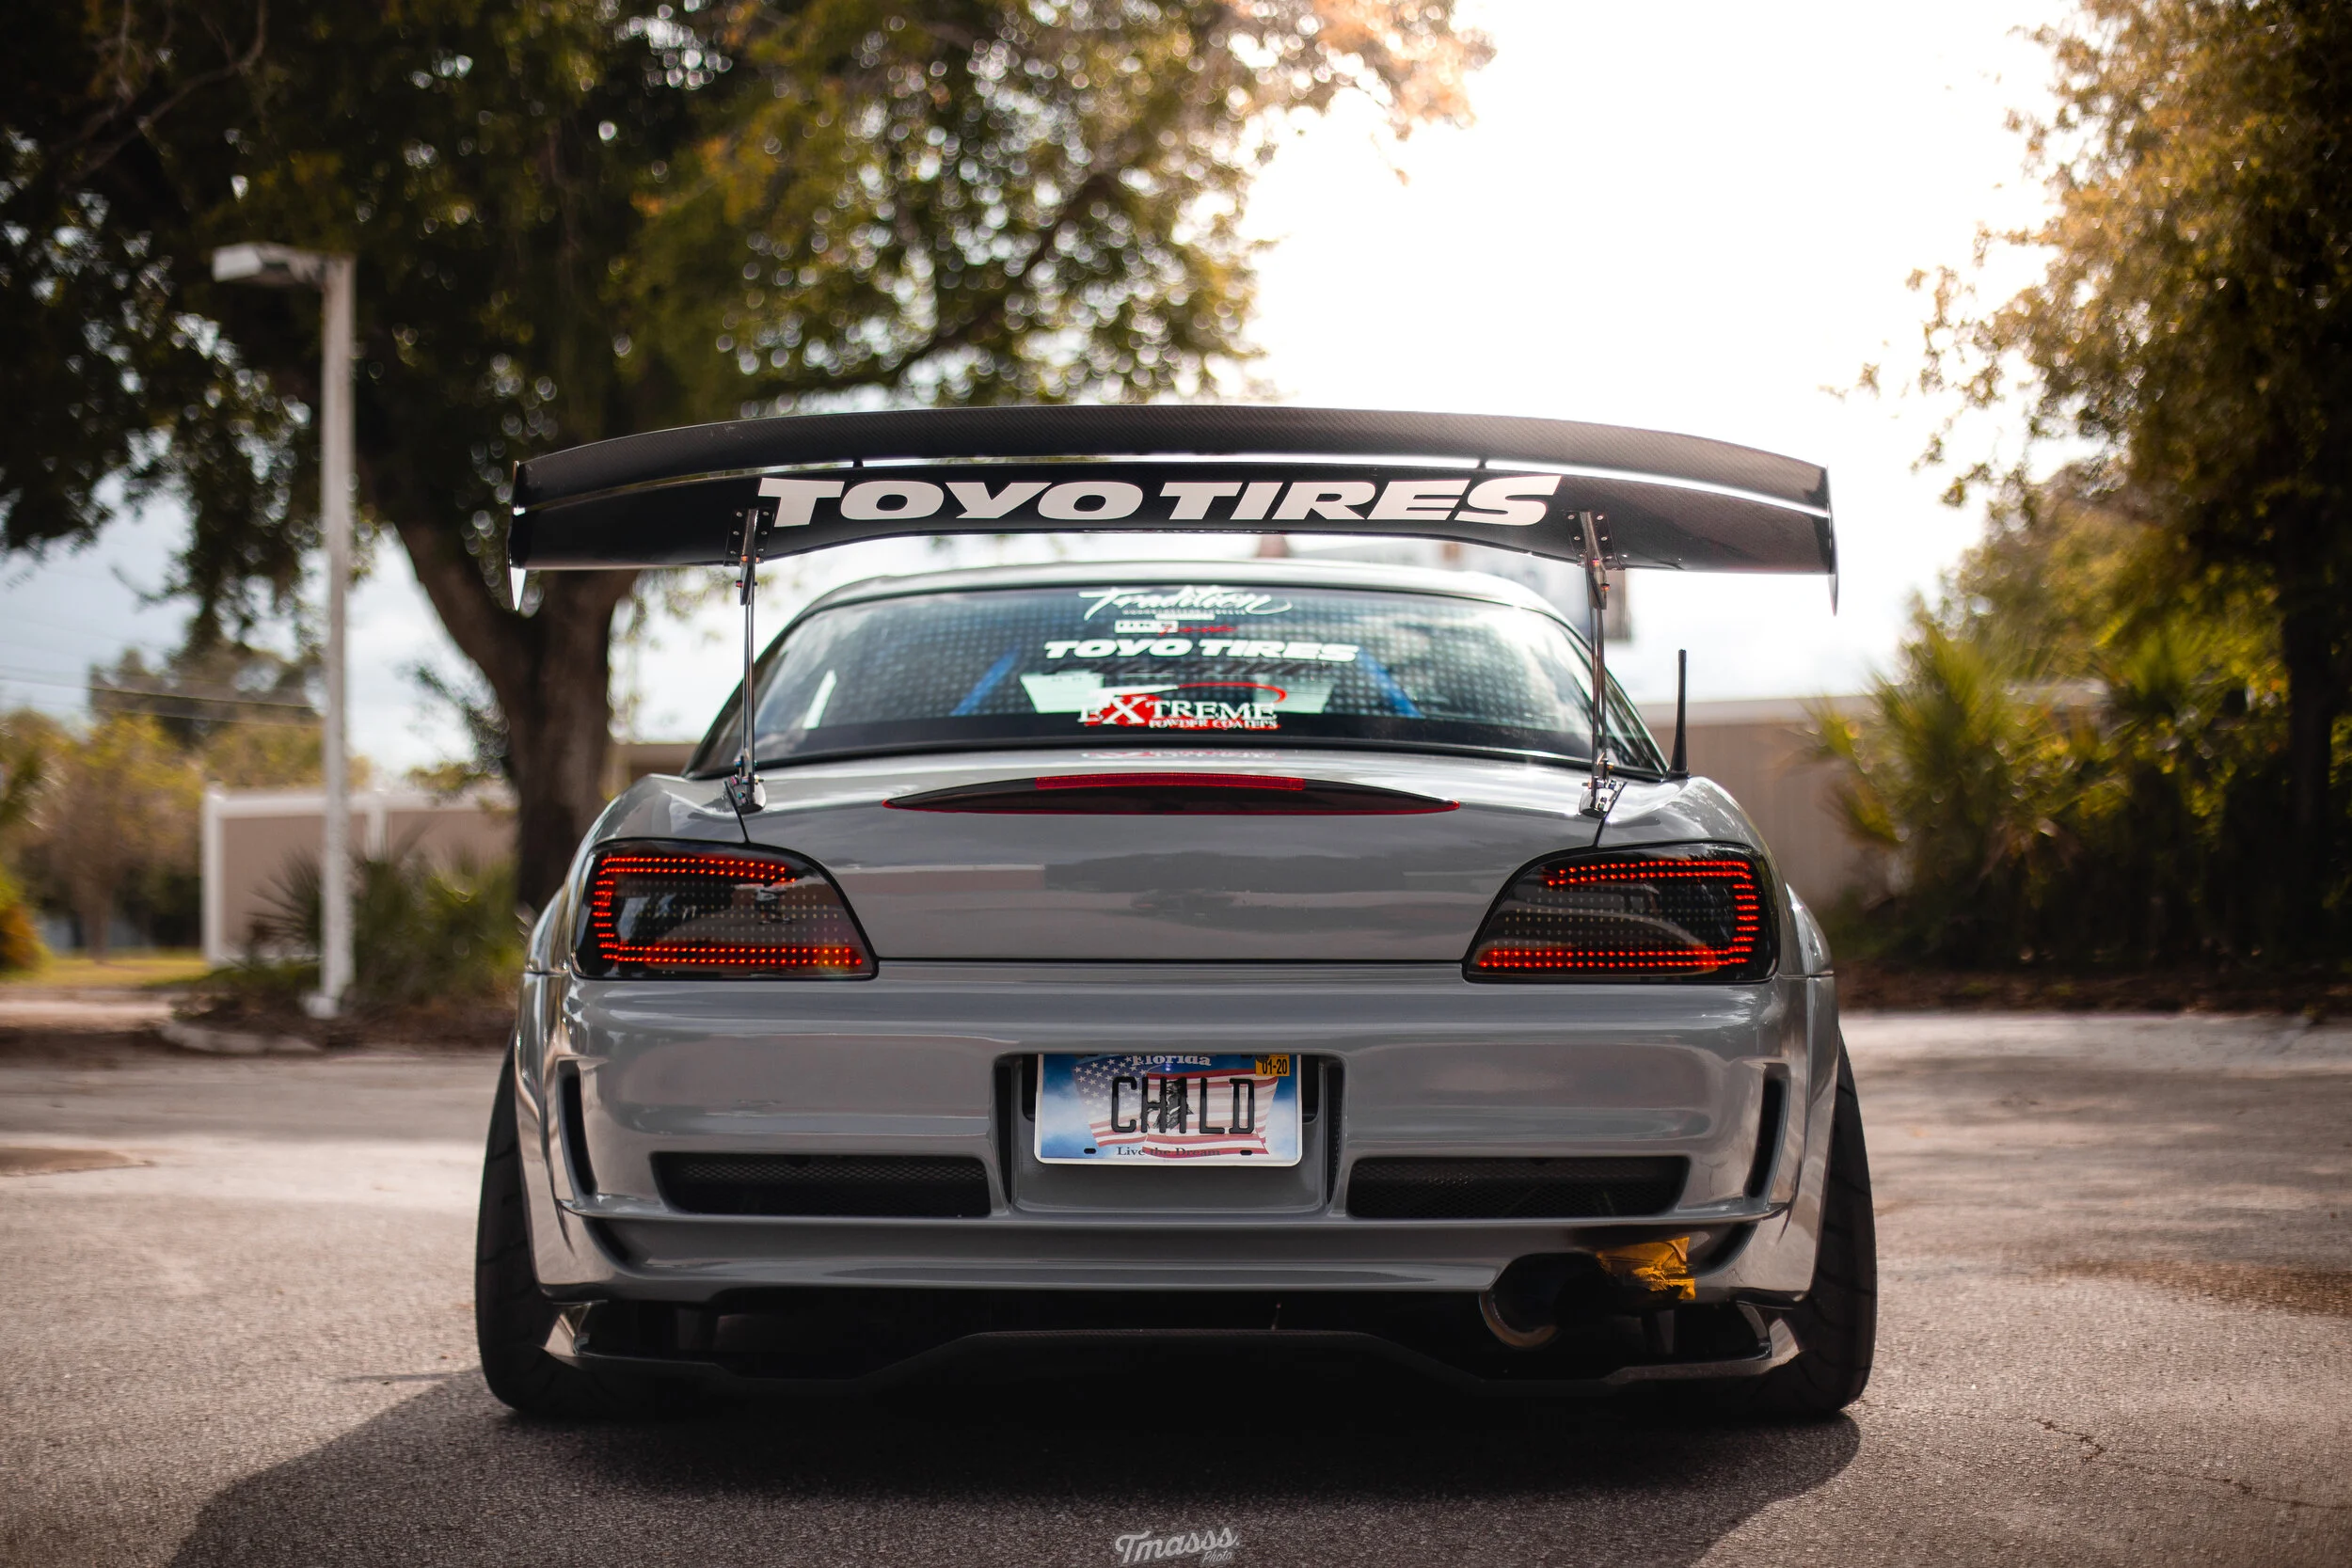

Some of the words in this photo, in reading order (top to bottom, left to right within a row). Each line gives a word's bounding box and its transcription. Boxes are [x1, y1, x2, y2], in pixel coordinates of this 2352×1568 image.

[757, 477, 1145, 528] TOYO
[1160, 475, 1562, 527] TIRES
[1044, 639, 1192, 659] TOYO
[1198, 640, 1359, 662] TIRES
[1077, 694, 1279, 724] EXTREME
[1132, 1054, 1212, 1067] Florida
[1111, 1076, 1255, 1134] CHILD
[1117, 1146, 1146, 1156] Live
[1150, 1147, 1171, 1156] the
[1175, 1147, 1221, 1156] Dream
